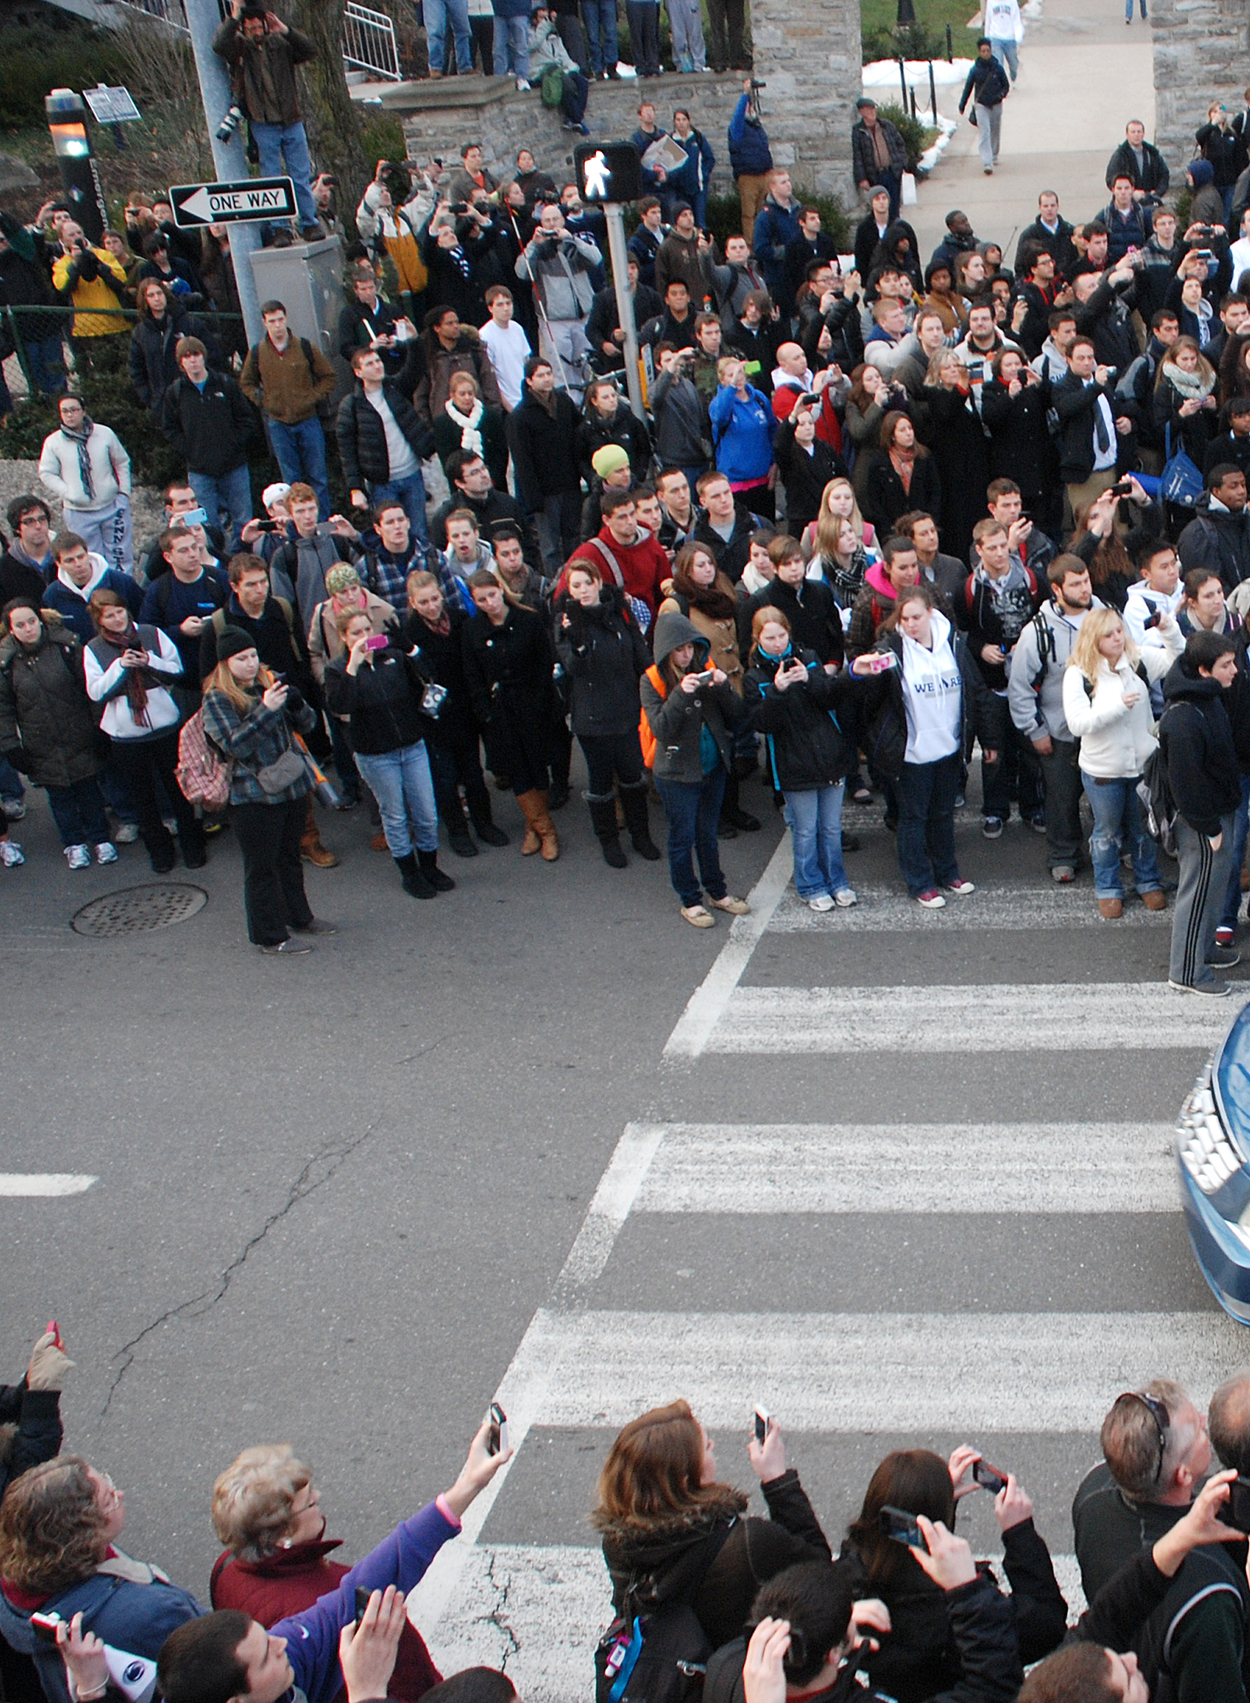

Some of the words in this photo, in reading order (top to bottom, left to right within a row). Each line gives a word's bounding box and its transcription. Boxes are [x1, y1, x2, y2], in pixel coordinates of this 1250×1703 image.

[209, 195, 242, 212] ONE
[247, 191, 280, 208] WAY
[113, 508, 125, 543] PENN
[914, 682, 935, 693] WE
